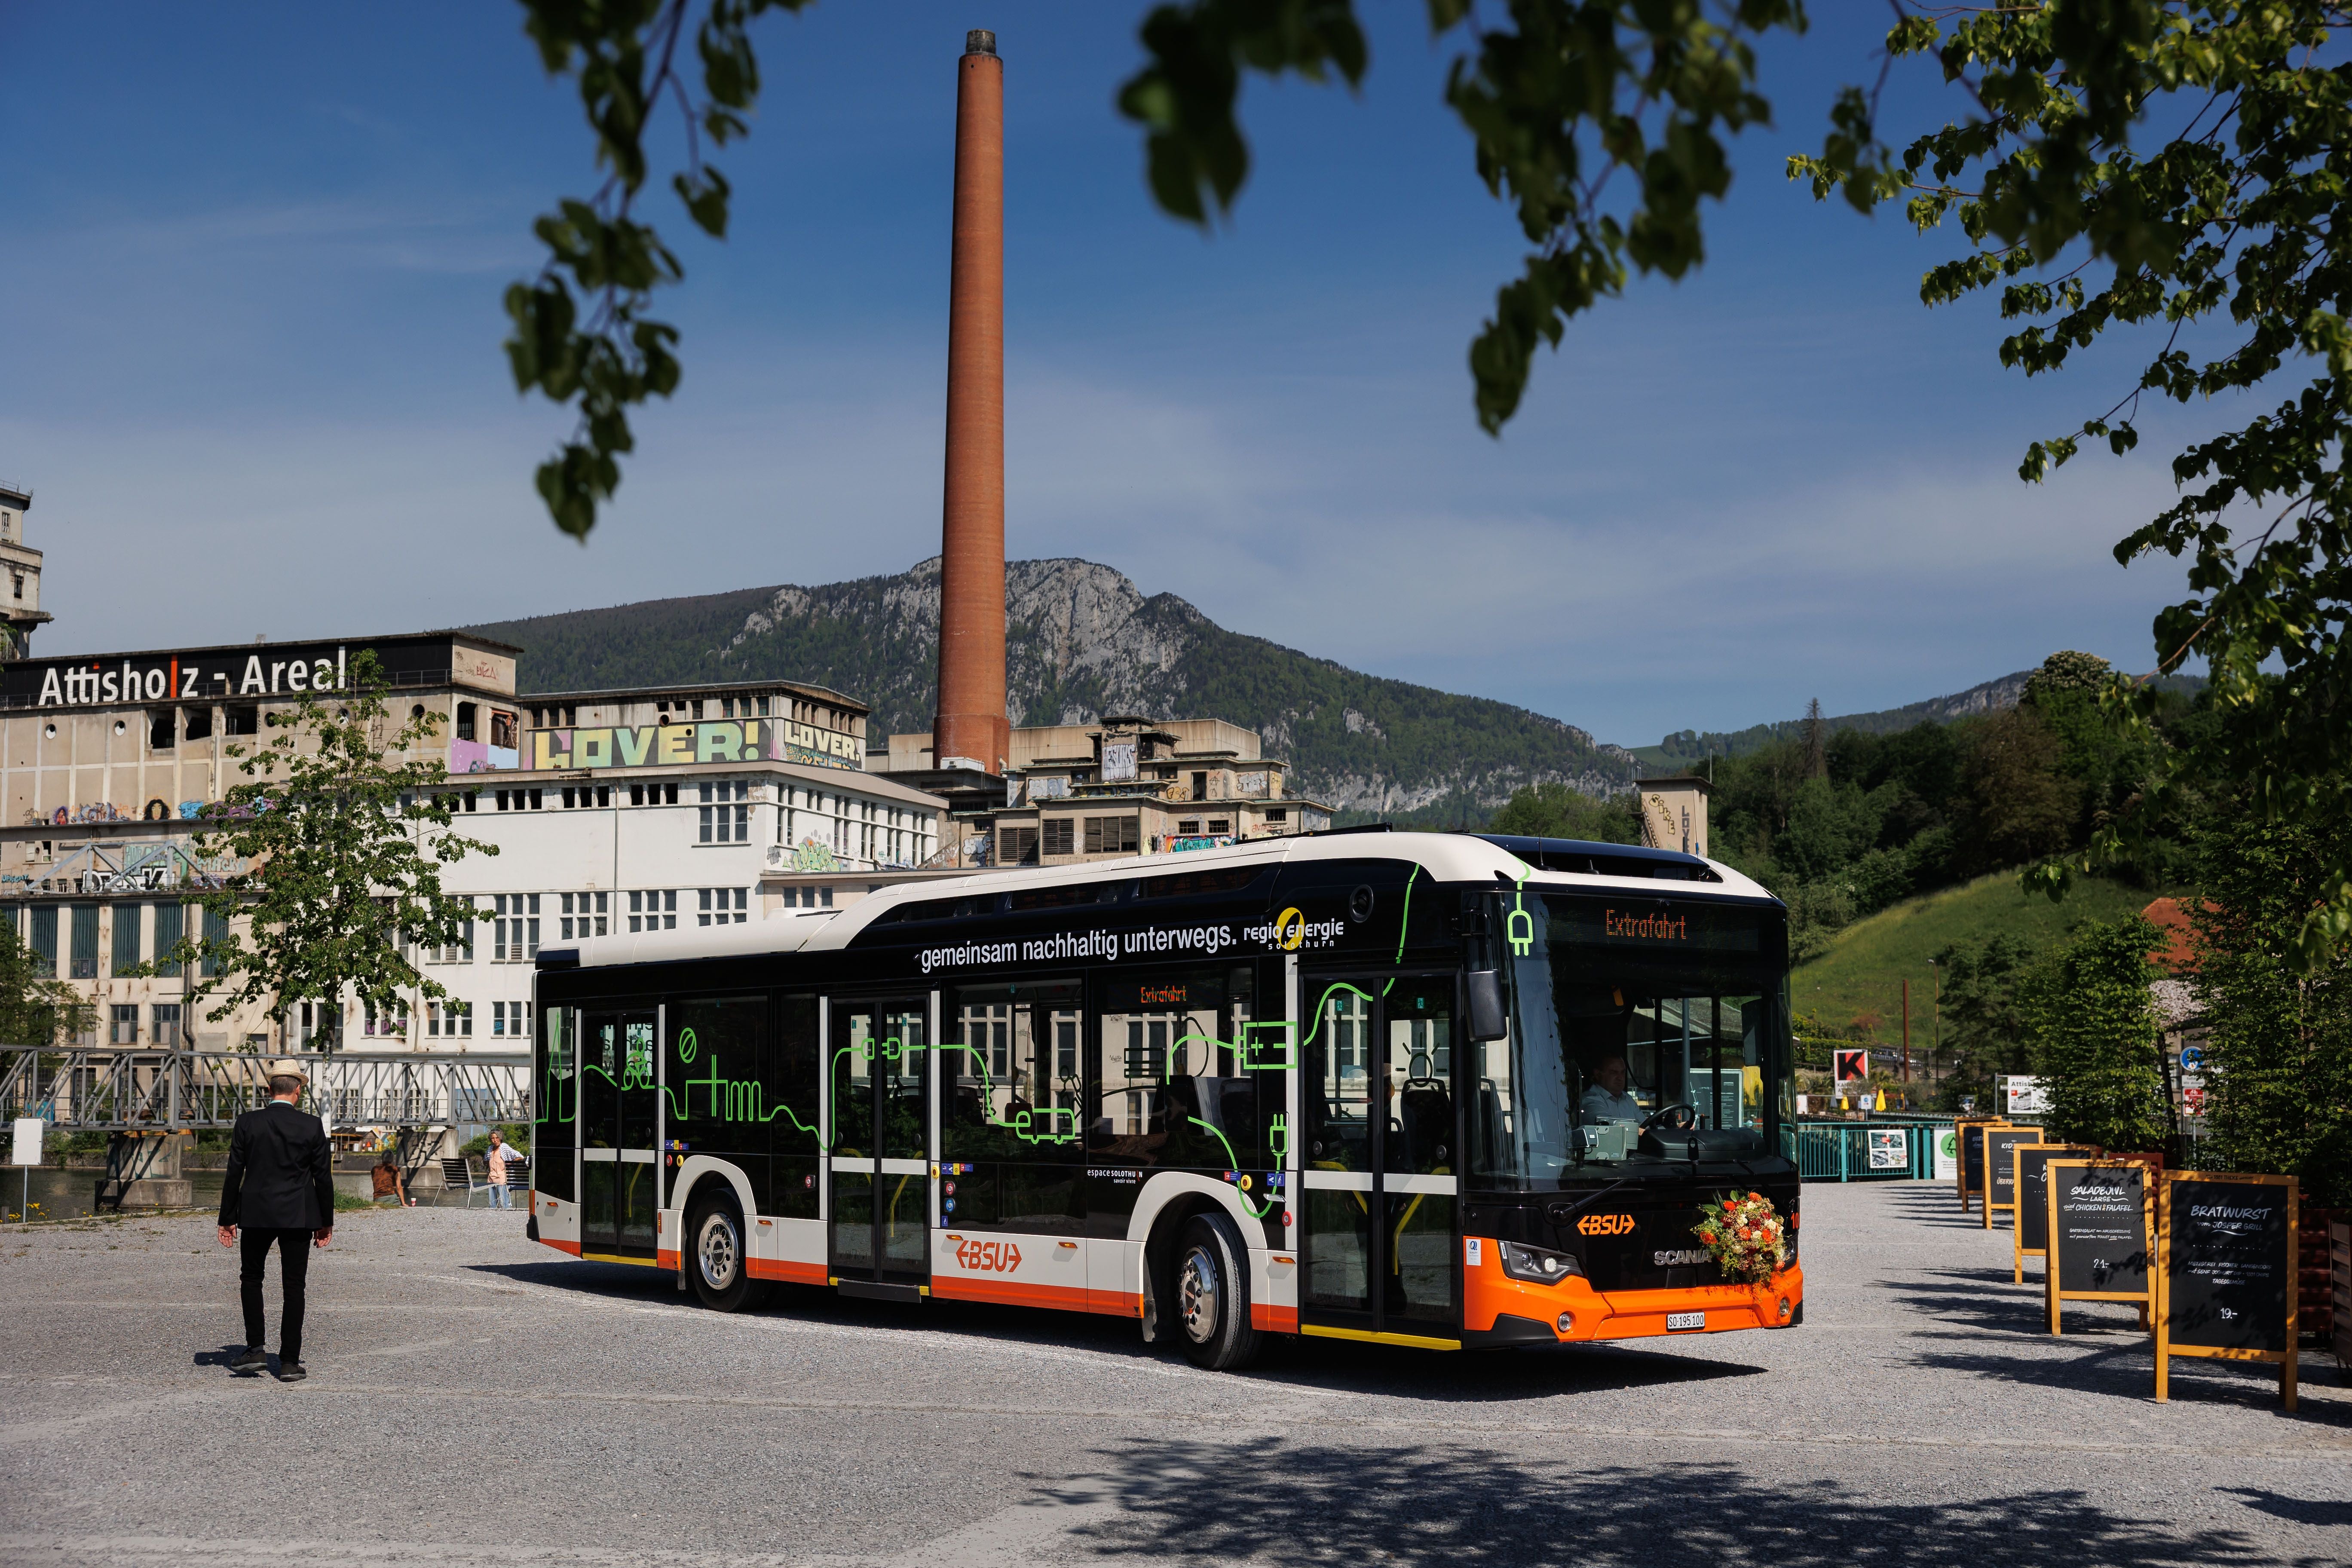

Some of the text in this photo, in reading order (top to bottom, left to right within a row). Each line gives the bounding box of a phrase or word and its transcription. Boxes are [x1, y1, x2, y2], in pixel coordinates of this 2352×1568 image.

[38, 655, 198, 706] Attisholz
[240, 646, 345, 694] Areal
[535, 721, 759, 769] LOVER!
[1244, 918, 1344, 943] regio energie
[1606, 909, 1686, 939] Extrafahrt
[921, 924, 1237, 973] gemeinsam nachhaltig unterwegs.
[1268, 940, 1334, 950] solothurn
[1141, 986, 1186, 1003] Extrafahrt
[1087, 1170, 1110, 1178] espace
[2070, 1186, 2126, 1195] SALADBOWL
[2190, 1205, 2272, 1220] BRATWURST
[1655, 1250, 1712, 1265] SCANIA
[1692, 1314, 1704, 1326] 100
